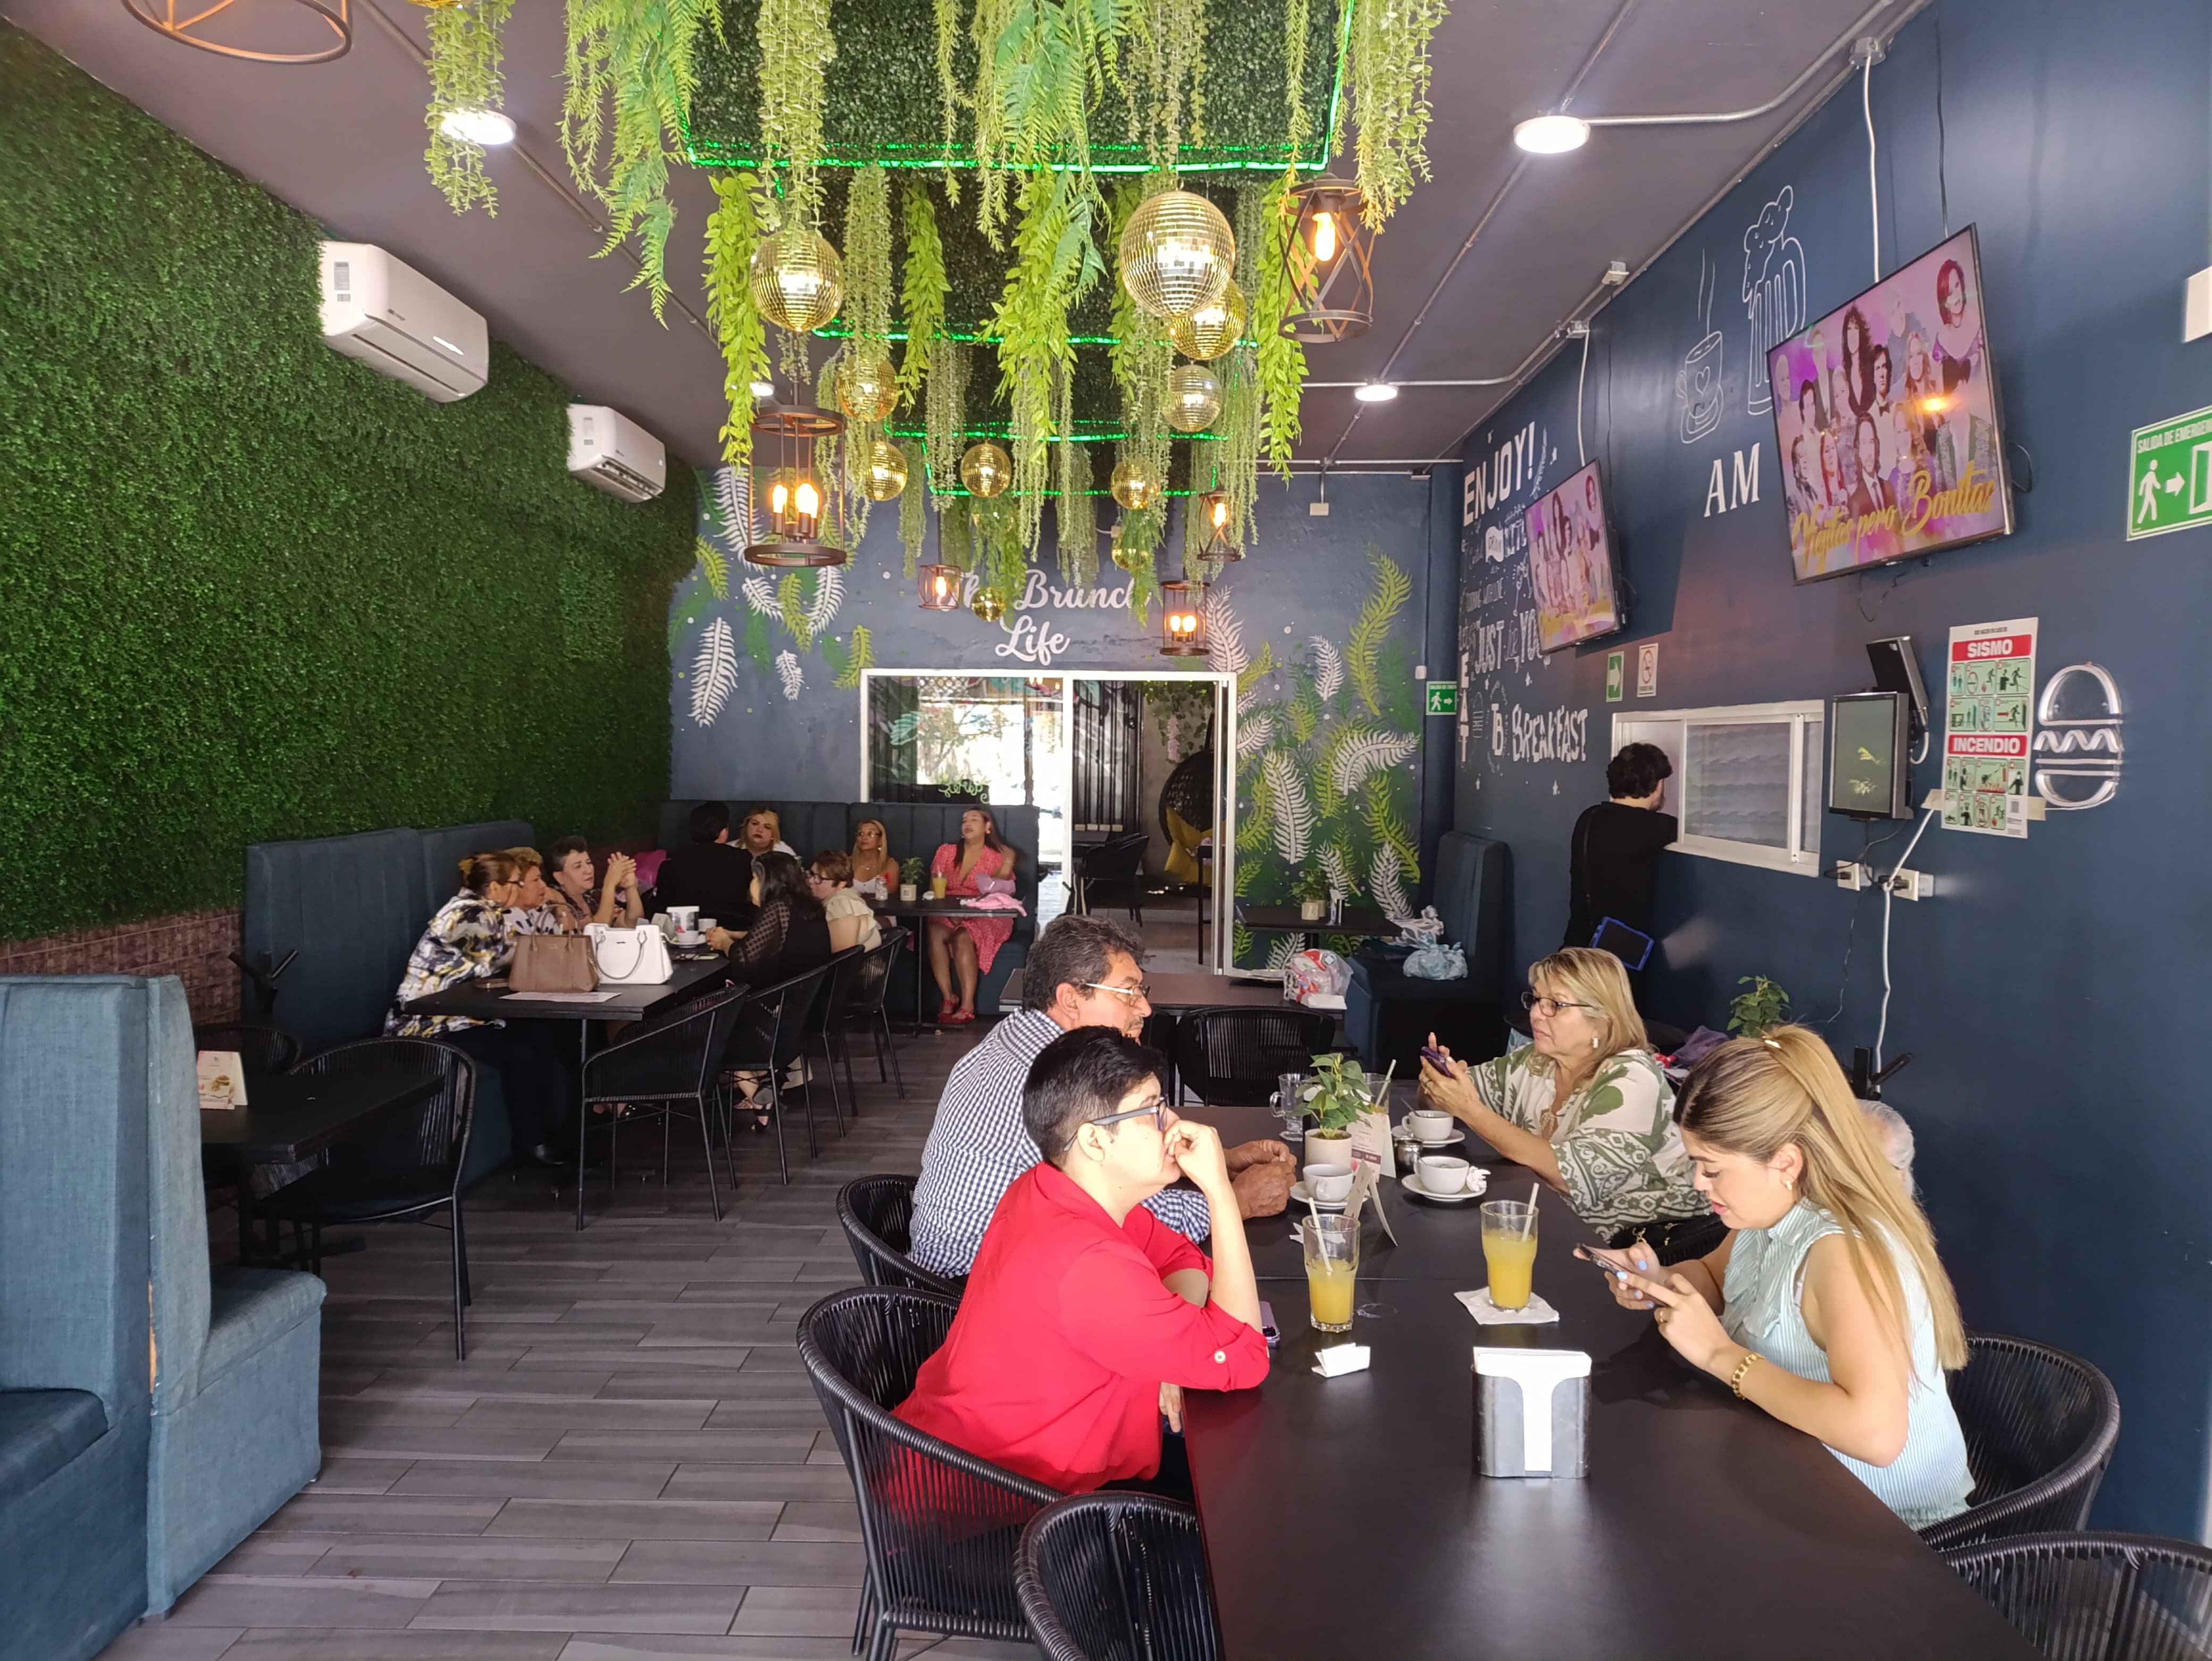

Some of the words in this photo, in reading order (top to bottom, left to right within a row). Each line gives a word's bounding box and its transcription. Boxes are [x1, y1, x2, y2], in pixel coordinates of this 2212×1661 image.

[2138, 433, 2163, 454] SALIDA
[2164, 430, 2174, 446] DE
[1464, 421, 1535, 527] ENJOY!
[1704, 442, 1760, 518] AM
[1013, 569, 1152, 611] Brunc
[995, 615, 1070, 666] Life
[1967, 639, 2013, 658] SISMO
[1460, 652, 1469, 762] EAT
[1512, 703, 1588, 763] BREAKFAST
[1953, 737, 2021, 754] INCENDIO
